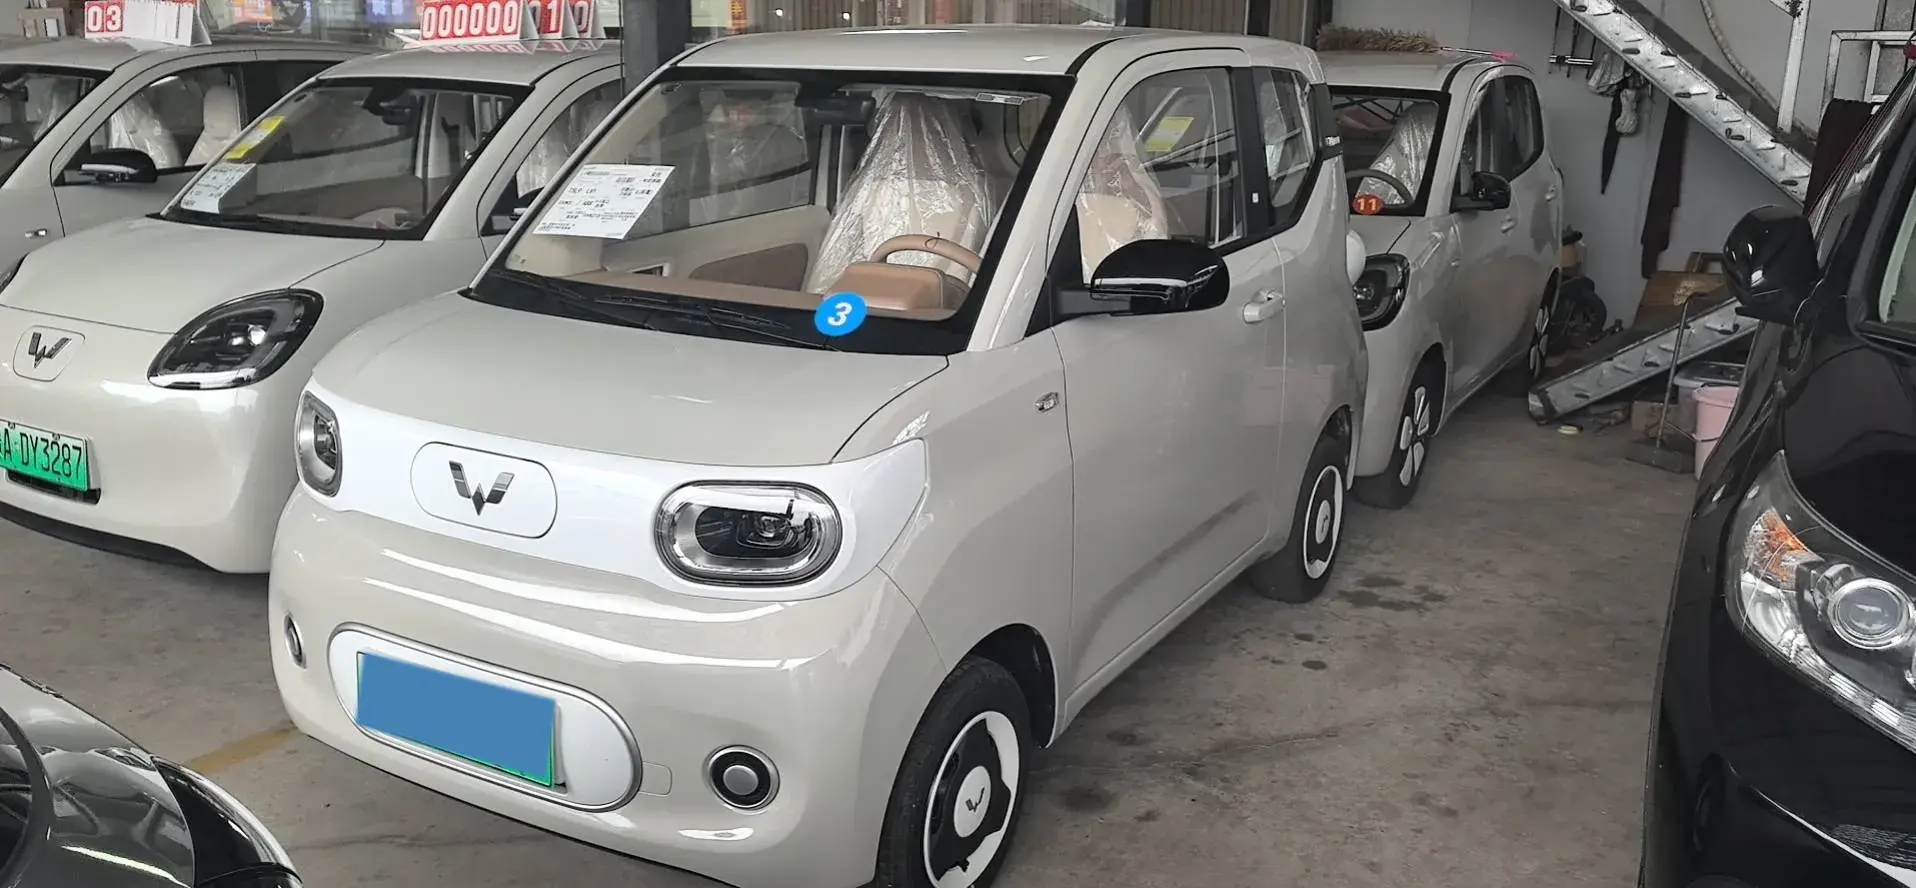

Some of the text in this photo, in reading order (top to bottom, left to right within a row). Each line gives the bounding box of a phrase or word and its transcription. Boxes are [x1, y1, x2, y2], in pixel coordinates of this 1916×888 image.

[87, 5, 121, 32] 03
[422, 1, 518, 38] 000000
[1357, 198, 1377, 211] 11
[827, 302, 852, 326] 3
[0, 427, 82, 480] A·DY3287
